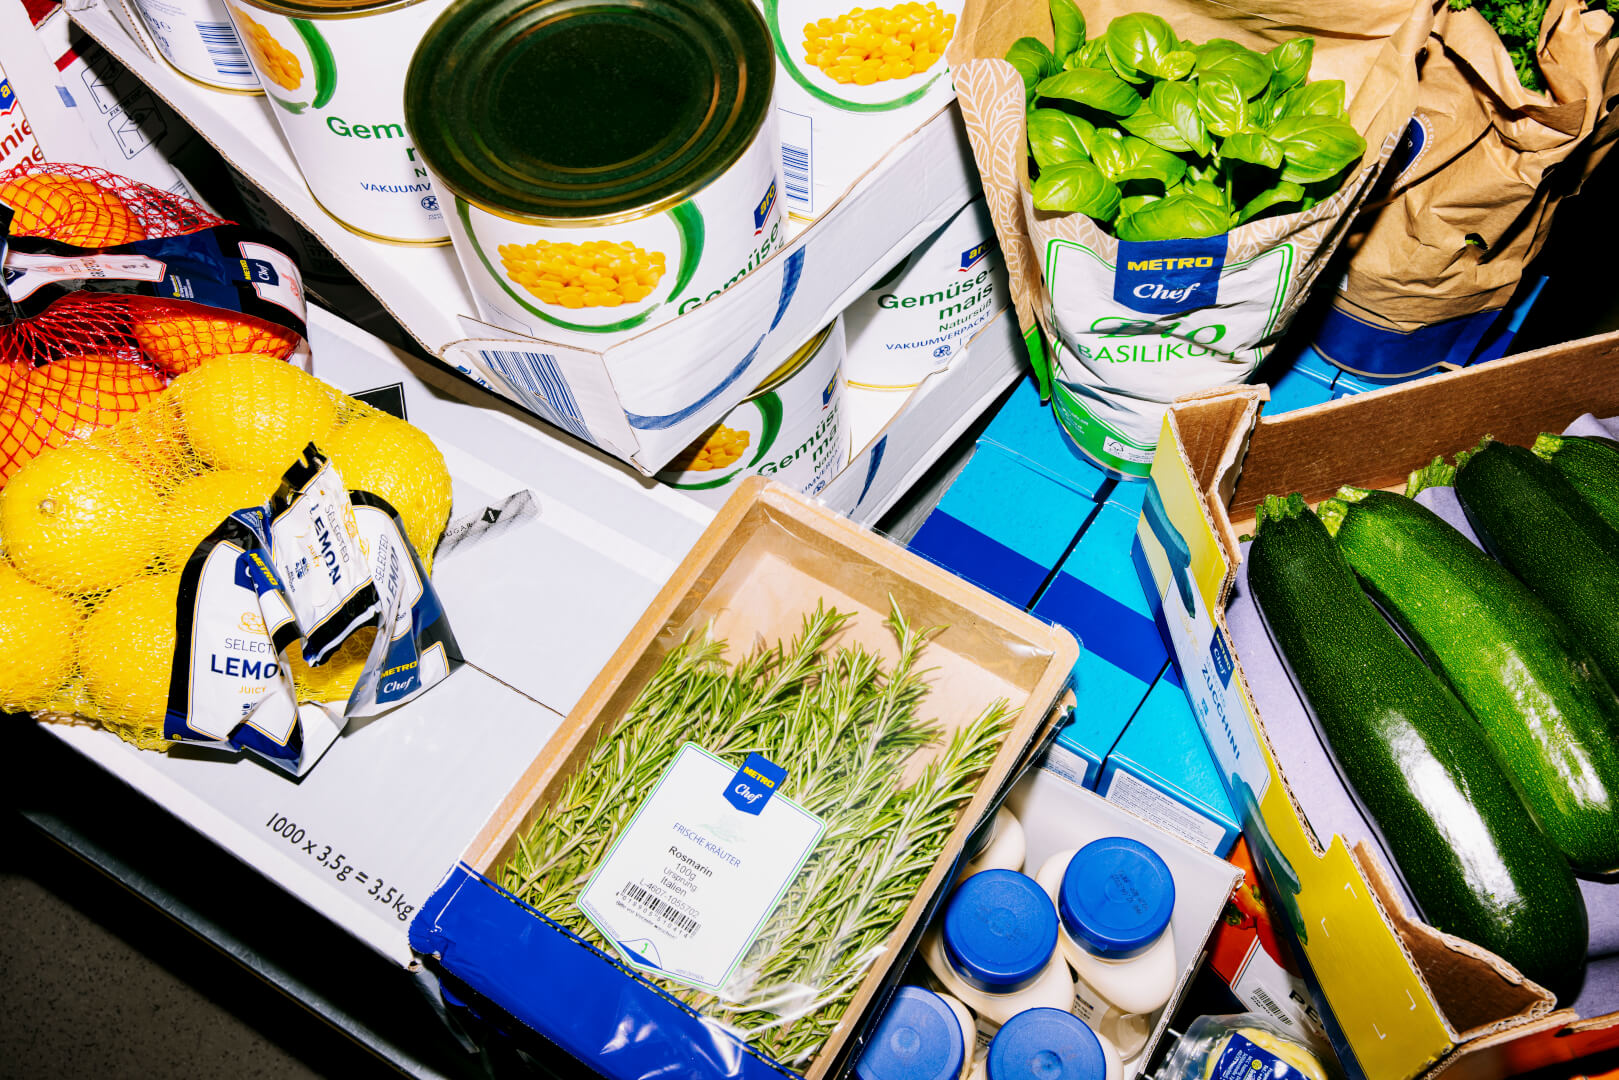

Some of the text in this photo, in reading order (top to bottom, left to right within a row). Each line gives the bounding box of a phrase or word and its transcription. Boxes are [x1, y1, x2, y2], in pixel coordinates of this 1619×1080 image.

[0, 119, 32, 162] nie
[760, 184, 776, 216] aro
[1127, 256, 1214, 271] METRO
[877, 266, 995, 310] Gemüse-
[938, 283, 993, 320] mais
[1132, 282, 1201, 304] Chef
[885, 309, 991, 351] VAKUUMVERPACKT
[938, 298, 992, 333] Natursüß
[441, 521, 476, 538] UGAR
[249, 552, 279, 586] METRO
[374, 534, 389, 584] SELECTED
[224, 637, 276, 655] SELECT
[211, 653, 285, 680] LEMO
[381, 660, 418, 680] METRO
[1213, 647, 1226, 676] Chef
[383, 676, 415, 695] Chef
[1202, 663, 1240, 760] ZUCCHINI
[743, 766, 775, 789] METRO
[734, 783, 764, 805] Chef
[266, 812, 305, 844] 1000
[302, 840, 318, 854] x
[316, 845, 354, 882] 3,5g
[672, 822, 742, 869] FRISCHE KRÄUTER
[668, 845, 713, 878] Rosmarin
[675, 863, 697, 882] 100g
[660, 875, 687, 897] Italien
[663, 866, 698, 893] Ursprung
